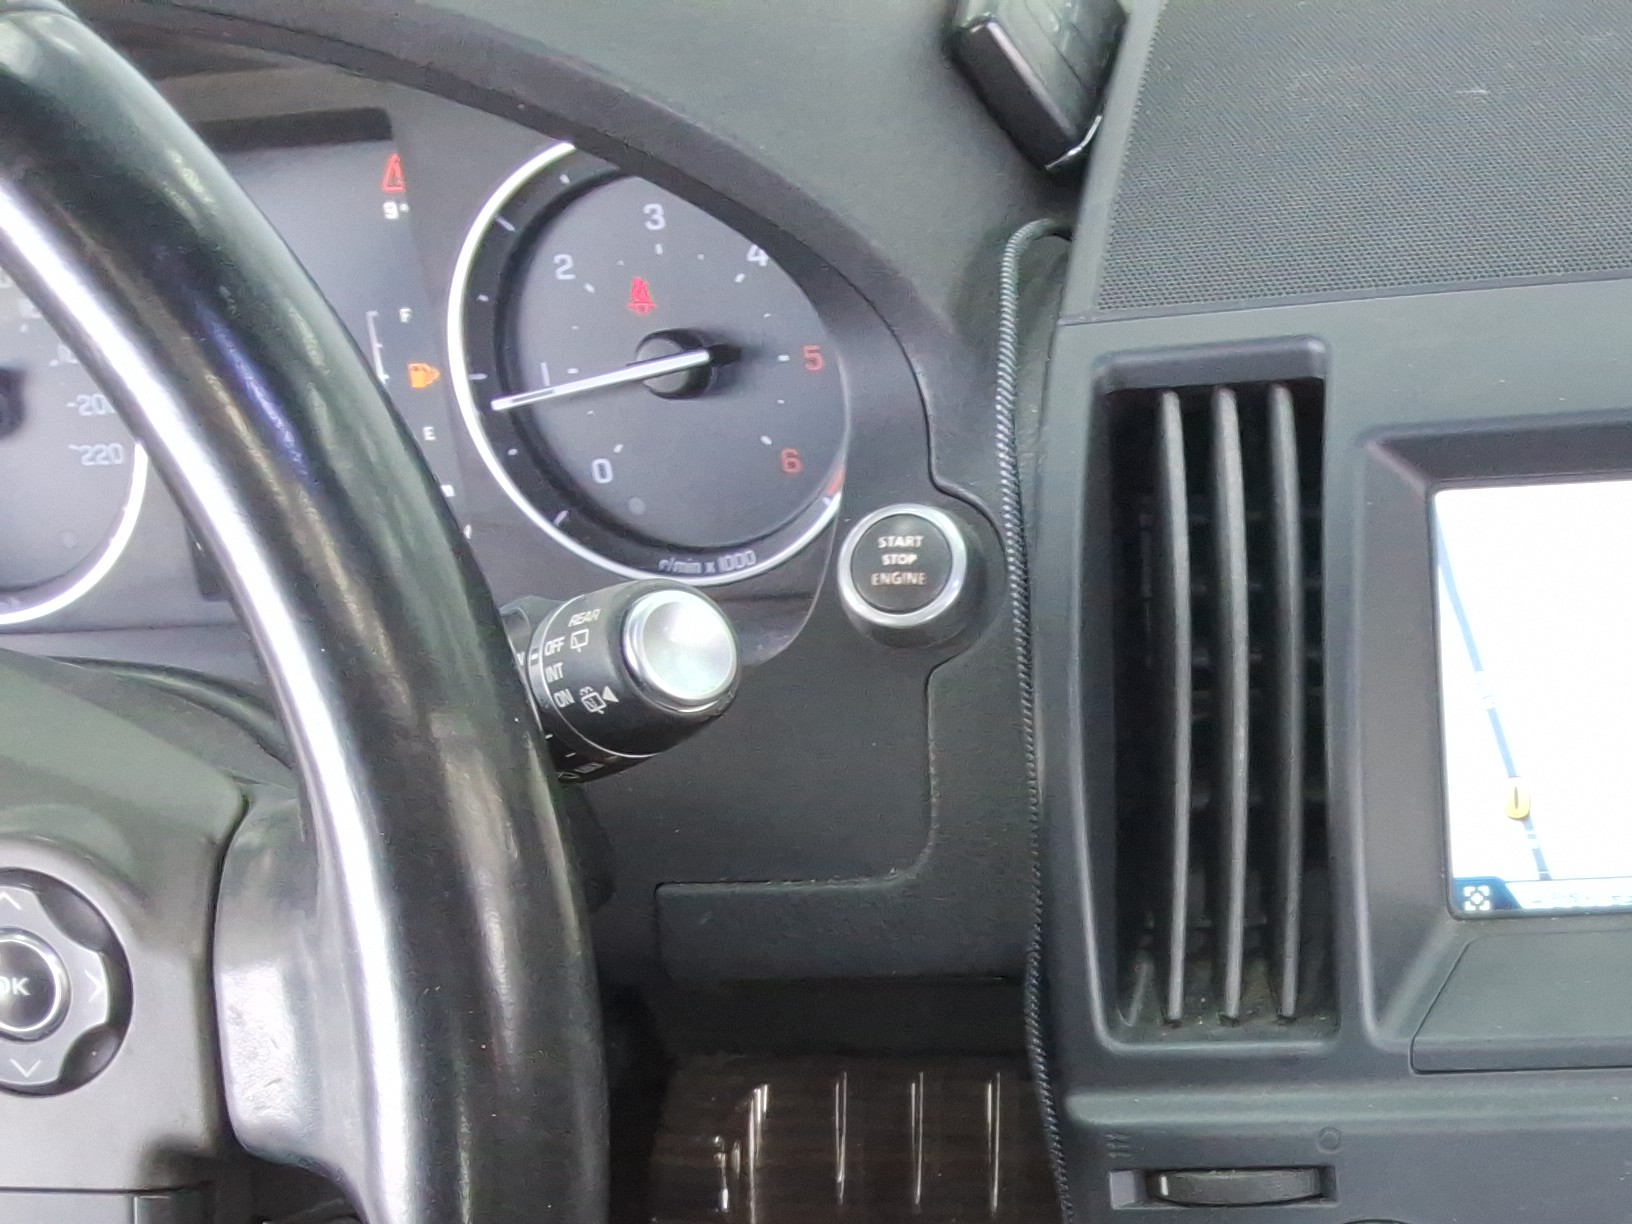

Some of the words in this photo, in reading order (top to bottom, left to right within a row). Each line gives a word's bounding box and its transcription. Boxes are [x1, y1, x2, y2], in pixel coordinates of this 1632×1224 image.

[643, 203, 666, 230] 3
[553, 254, 576, 280] 2
[746, 244, 768, 267] 4
[803, 345, 825, 371] 5
[76, 393, 116, 416] 20
[423, 426, 436, 441] E
[80, 443, 124, 466] 220
[781, 448, 802, 473] 6
[592, 458, 613, 484] 0
[877, 535, 925, 548] START
[718, 549, 757, 572] 1000
[881, 553, 918, 566] STOP
[870, 572, 928, 586] ENGINE
[568, 608, 601, 628] REAR
[544, 636, 566, 656] OFF
[545, 662, 564, 683] INT
[553, 688, 576, 708] ON
